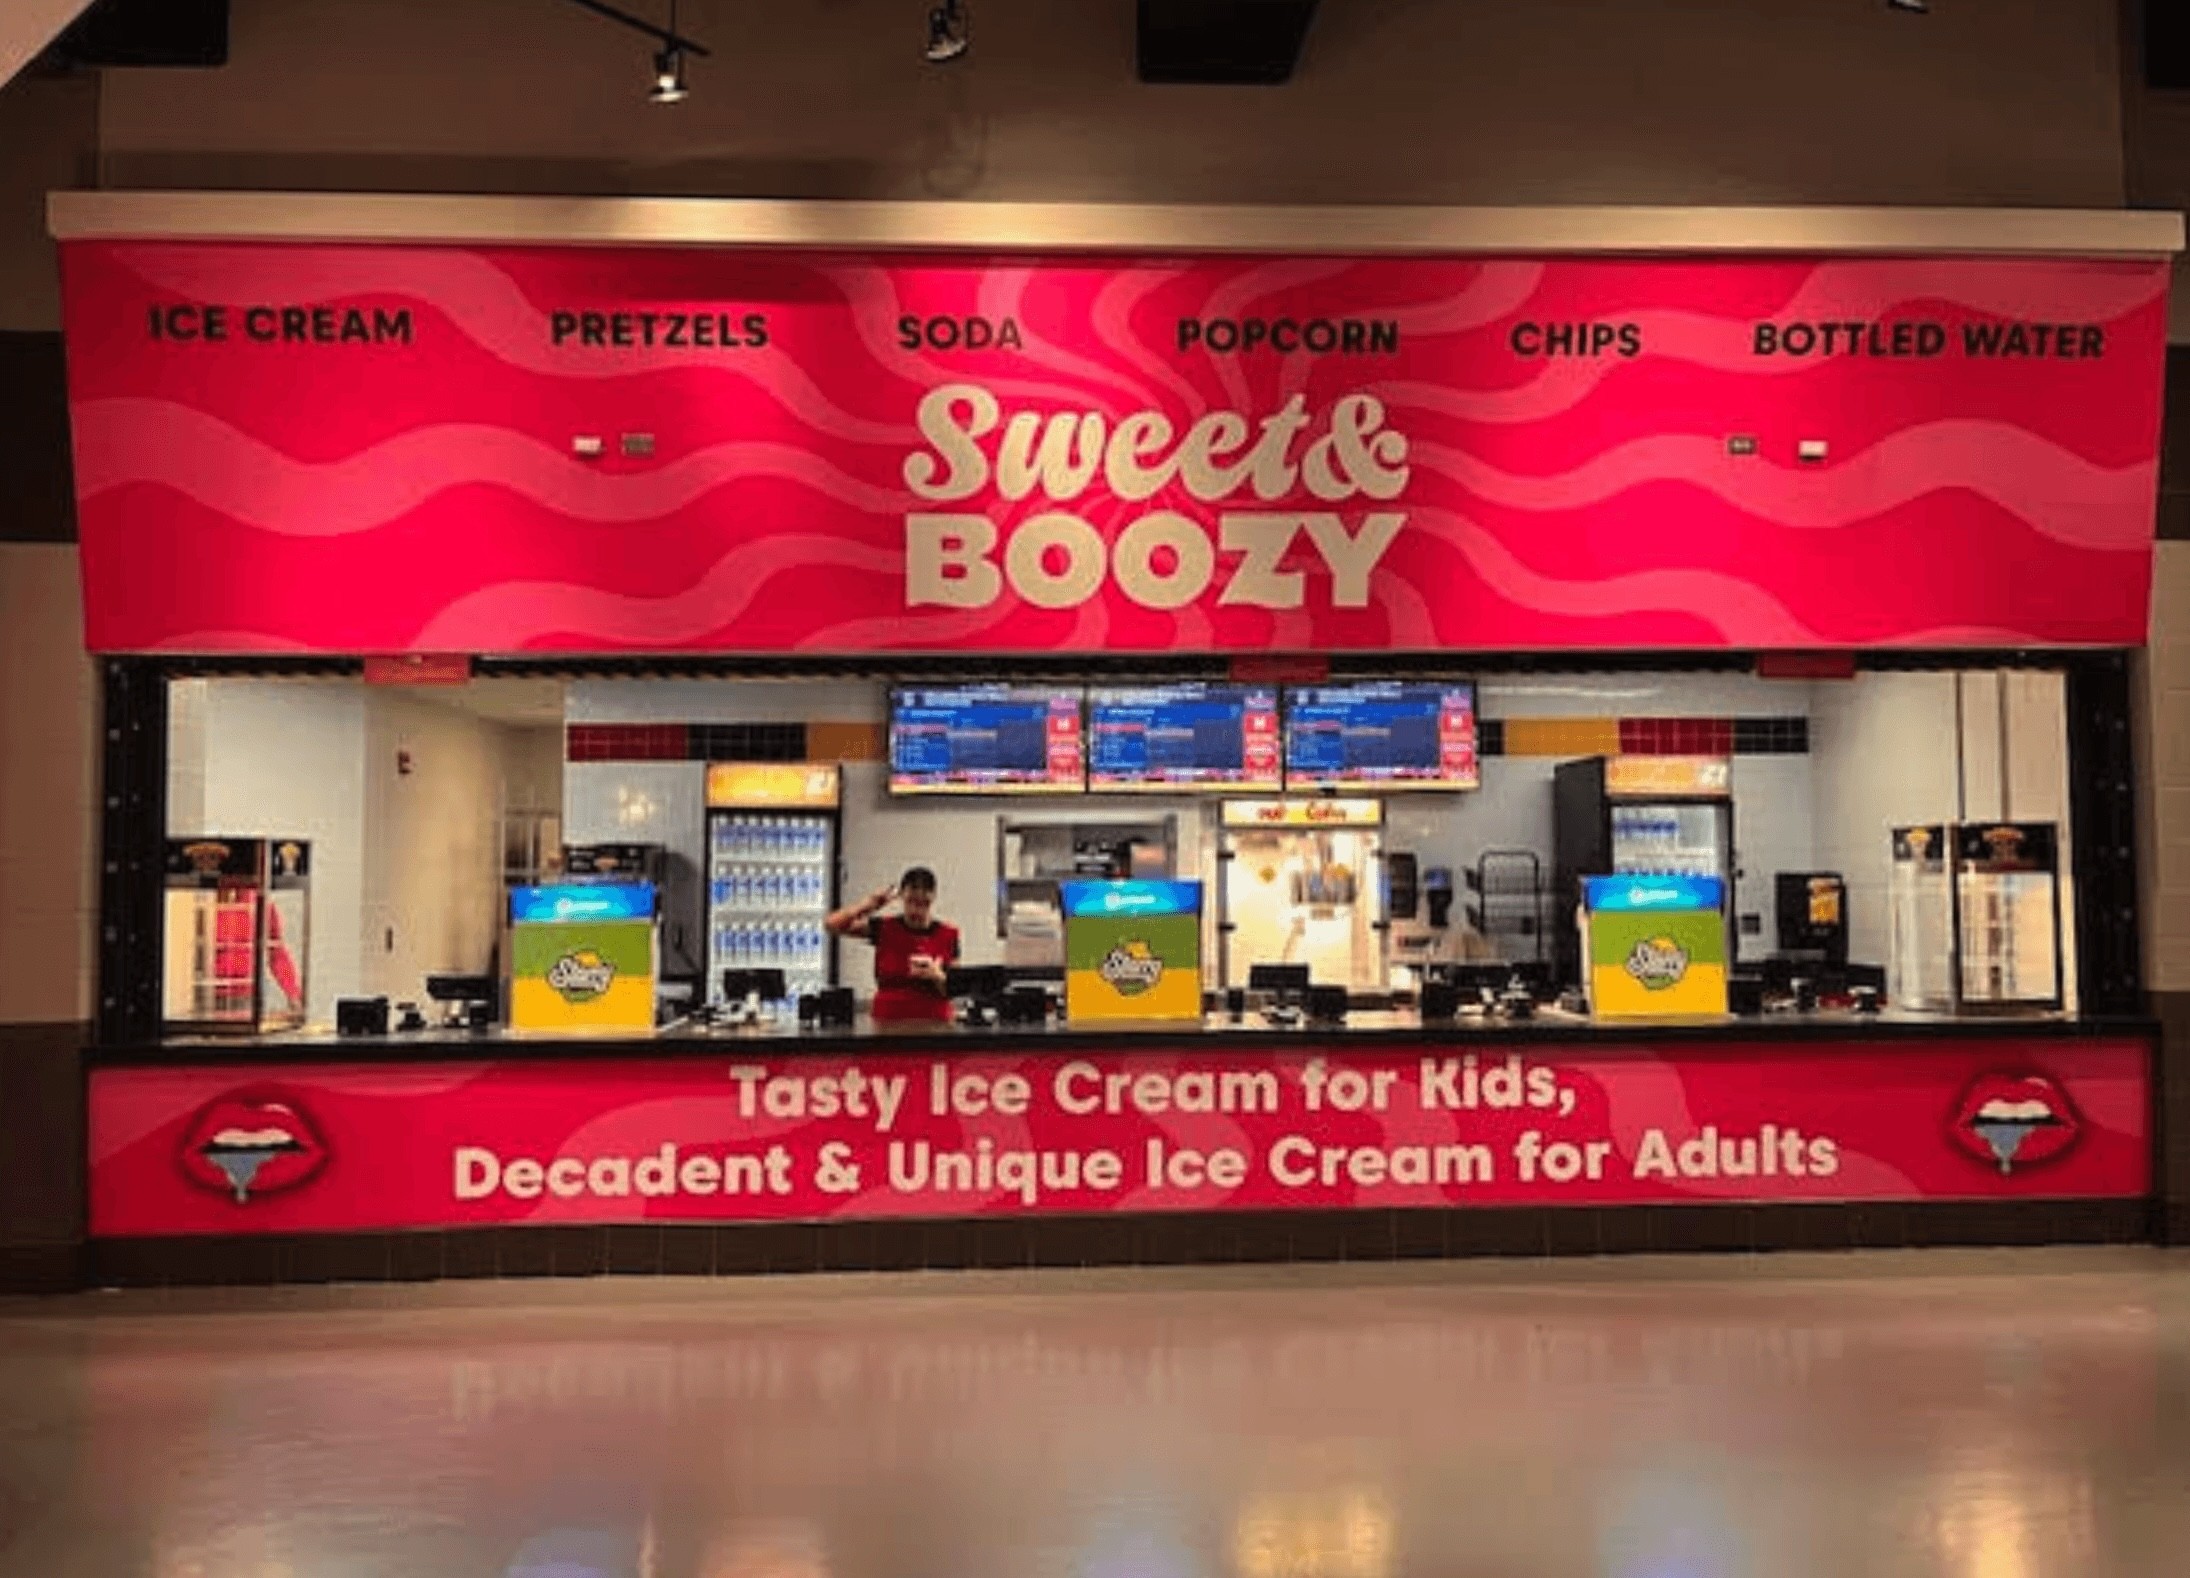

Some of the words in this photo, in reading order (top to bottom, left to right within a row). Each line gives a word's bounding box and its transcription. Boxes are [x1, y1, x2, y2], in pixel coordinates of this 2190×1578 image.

[146, 303, 227, 343] ICE
[244, 306, 413, 345] CREAM
[551, 311, 768, 348] PRETZELS
[897, 315, 1023, 350] SODA
[1177, 317, 1399, 356] POPCORN
[1511, 322, 1641, 357] CHIPS
[1754, 321, 1947, 358] BOTTLED
[1961, 322, 2105, 360] WATER
[905, 510, 1408, 609] BOOZY
[728, 1063, 907, 1131] Tasty
[931, 1064, 1031, 1116] Ice
[1054, 1062, 1279, 1114] Cream
[1300, 1058, 1398, 1111] for
[1419, 1056, 1576, 1115] Kids,
[454, 1144, 792, 1201] Decadent
[815, 1142, 861, 1193] &
[887, 1139, 1123, 1205] Unique
[1147, 1138, 1246, 1188] Ice
[1269, 1136, 1493, 1186] Cream
[1513, 1131, 1611, 1181] for
[1633, 1124, 1839, 1178] Adults
